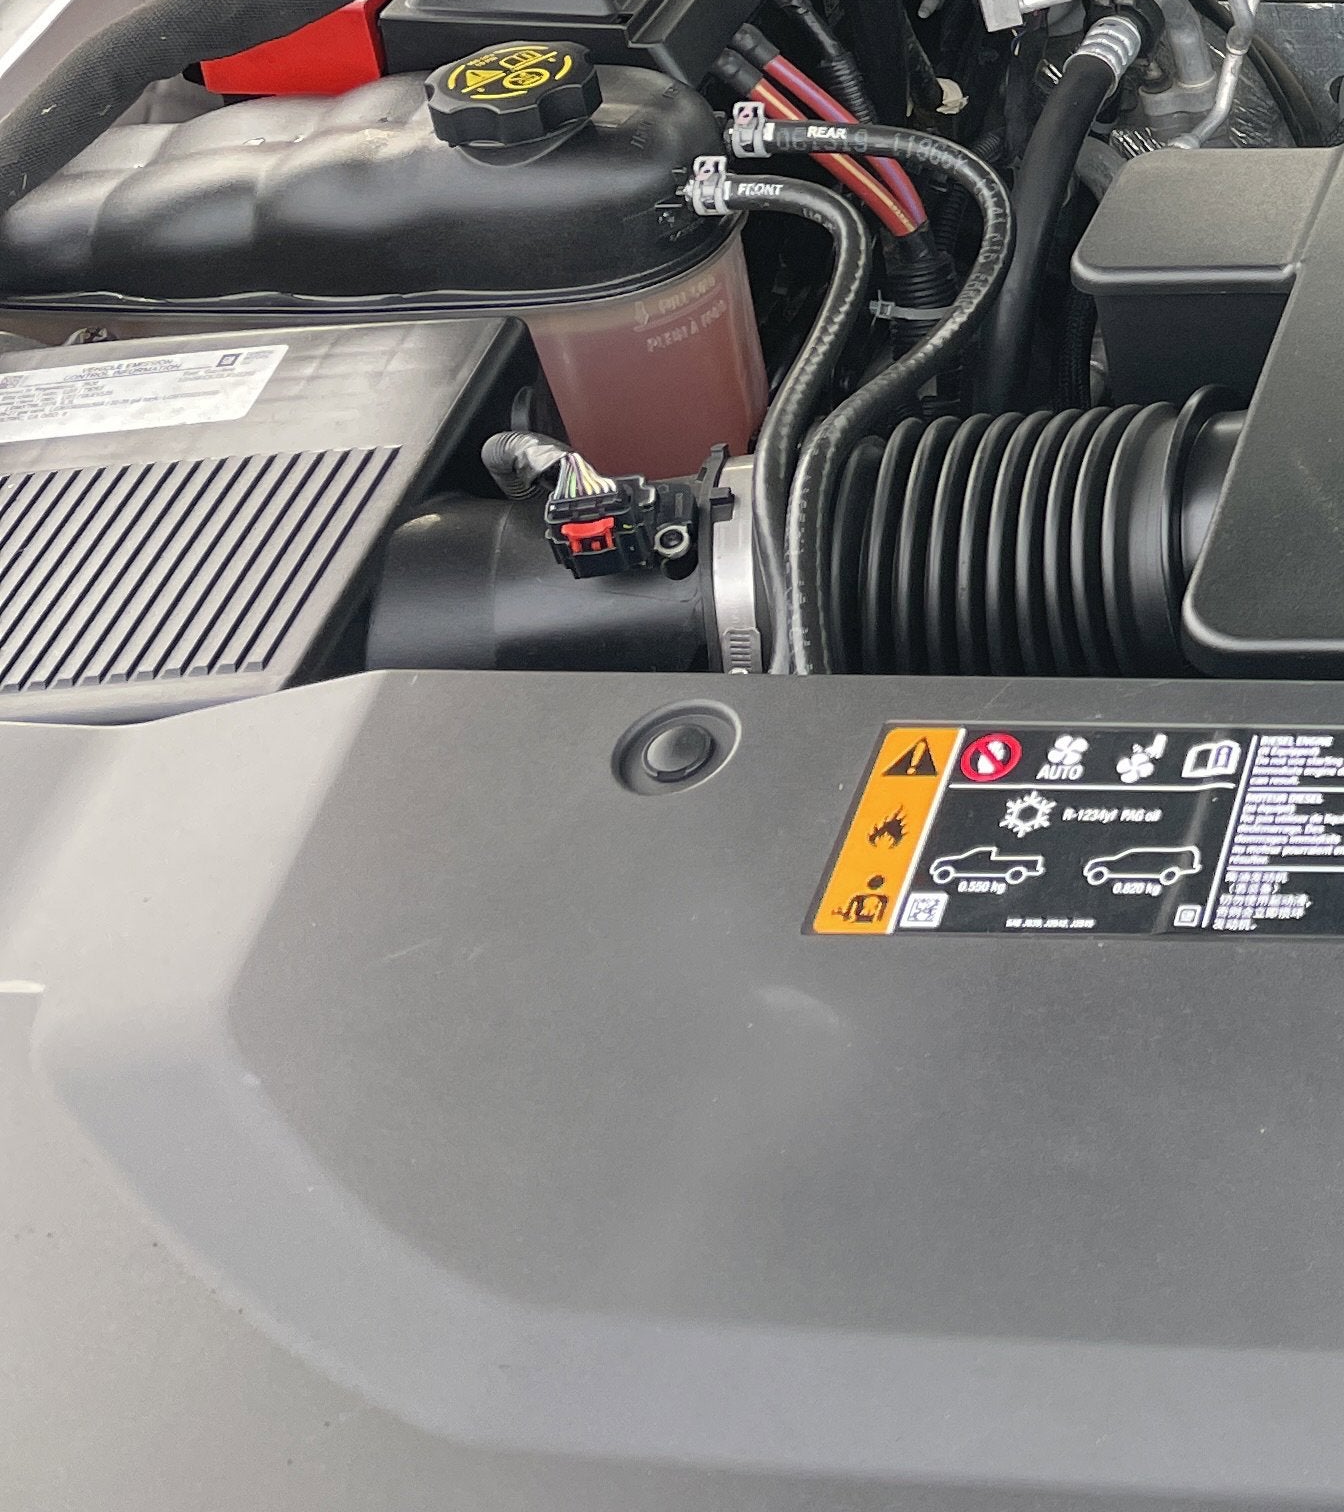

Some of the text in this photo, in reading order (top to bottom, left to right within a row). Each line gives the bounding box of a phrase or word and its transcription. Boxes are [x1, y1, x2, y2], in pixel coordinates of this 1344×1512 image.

[806, 126, 847, 140] REAR
[737, 183, 784, 197] FRONT
[1036, 764, 1084, 780] AUTO
[1062, 808, 1117, 824] R-1234yf
[1120, 808, 1144, 822] PAG
[957, 881, 1006, 895] 0.550 kg
[1112, 882, 1162, 896] 0.820 kg
